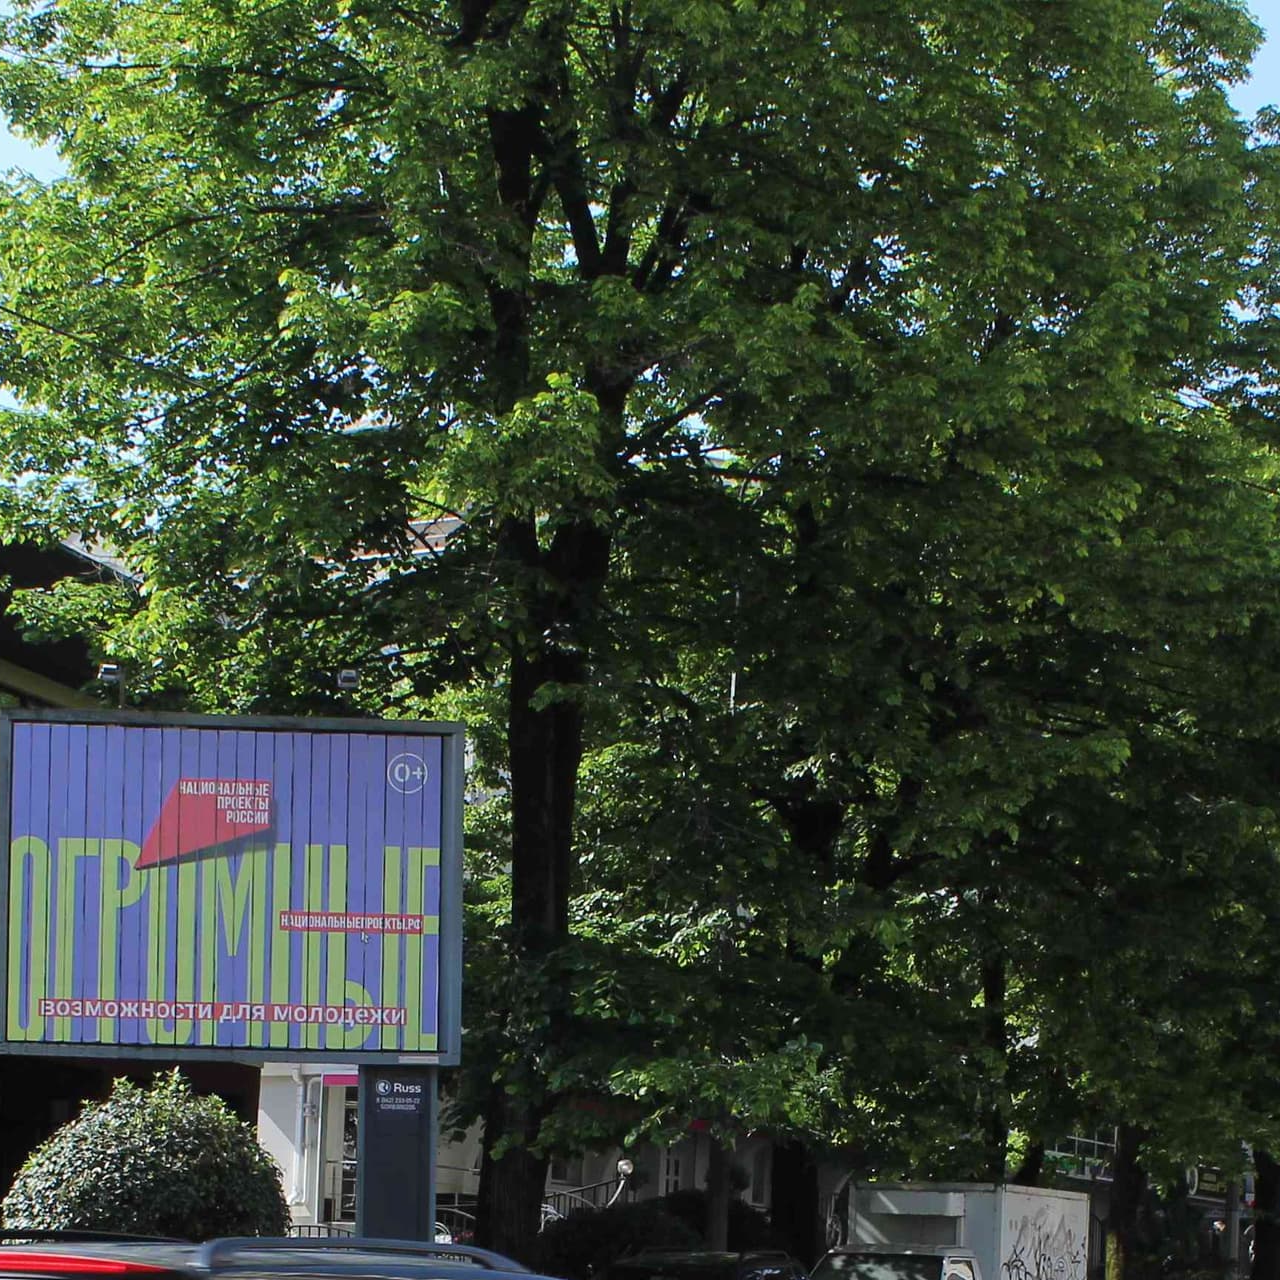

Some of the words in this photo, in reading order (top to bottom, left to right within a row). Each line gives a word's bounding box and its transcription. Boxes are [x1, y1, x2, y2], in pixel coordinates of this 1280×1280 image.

[394, 763, 424, 783] 0+
[180, 781, 270, 797] НАЦИОНАЛЬНЫЕ
[217, 796, 270, 810] ПРОЕКТЫ
[226, 810, 269, 825] РОССИИ
[281, 914, 422, 930] НАЦИОНАЛЬНЫЕПРОЕКТЫ.РФ
[6, 835, 440, 1051] ОГРОМНЫЕ
[393, 1082, 422, 1093] Russ
